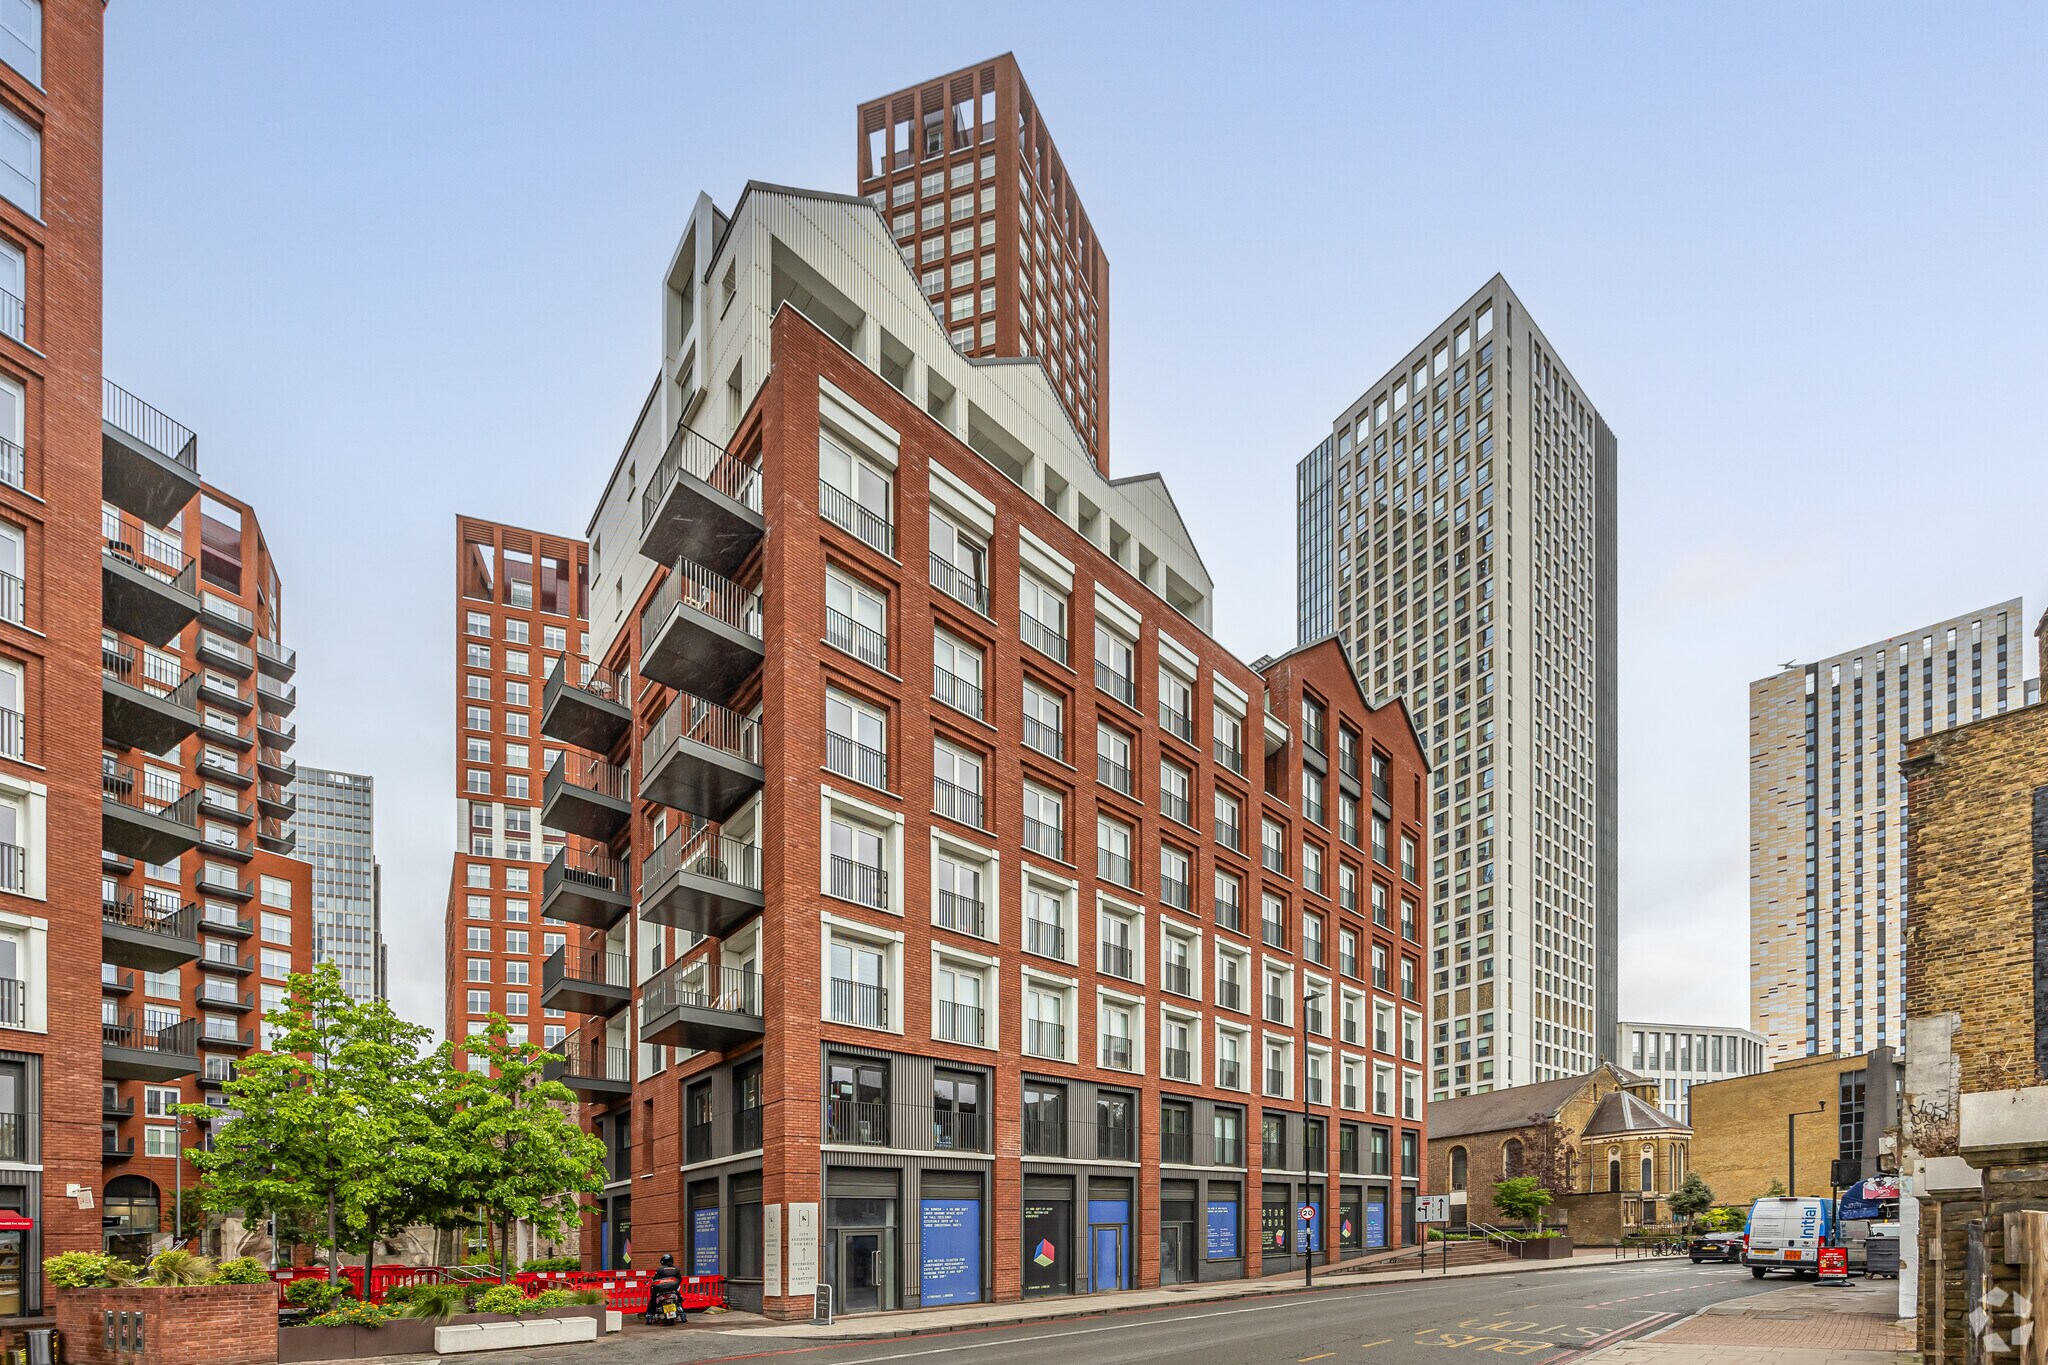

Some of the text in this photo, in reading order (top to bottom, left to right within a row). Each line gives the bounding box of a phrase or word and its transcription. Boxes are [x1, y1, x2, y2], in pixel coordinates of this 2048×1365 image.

[1800, 1207, 1817, 1238] Initial
[1458, 1319, 1613, 1338] STOP
[1414, 1333, 1555, 1355] BUS
